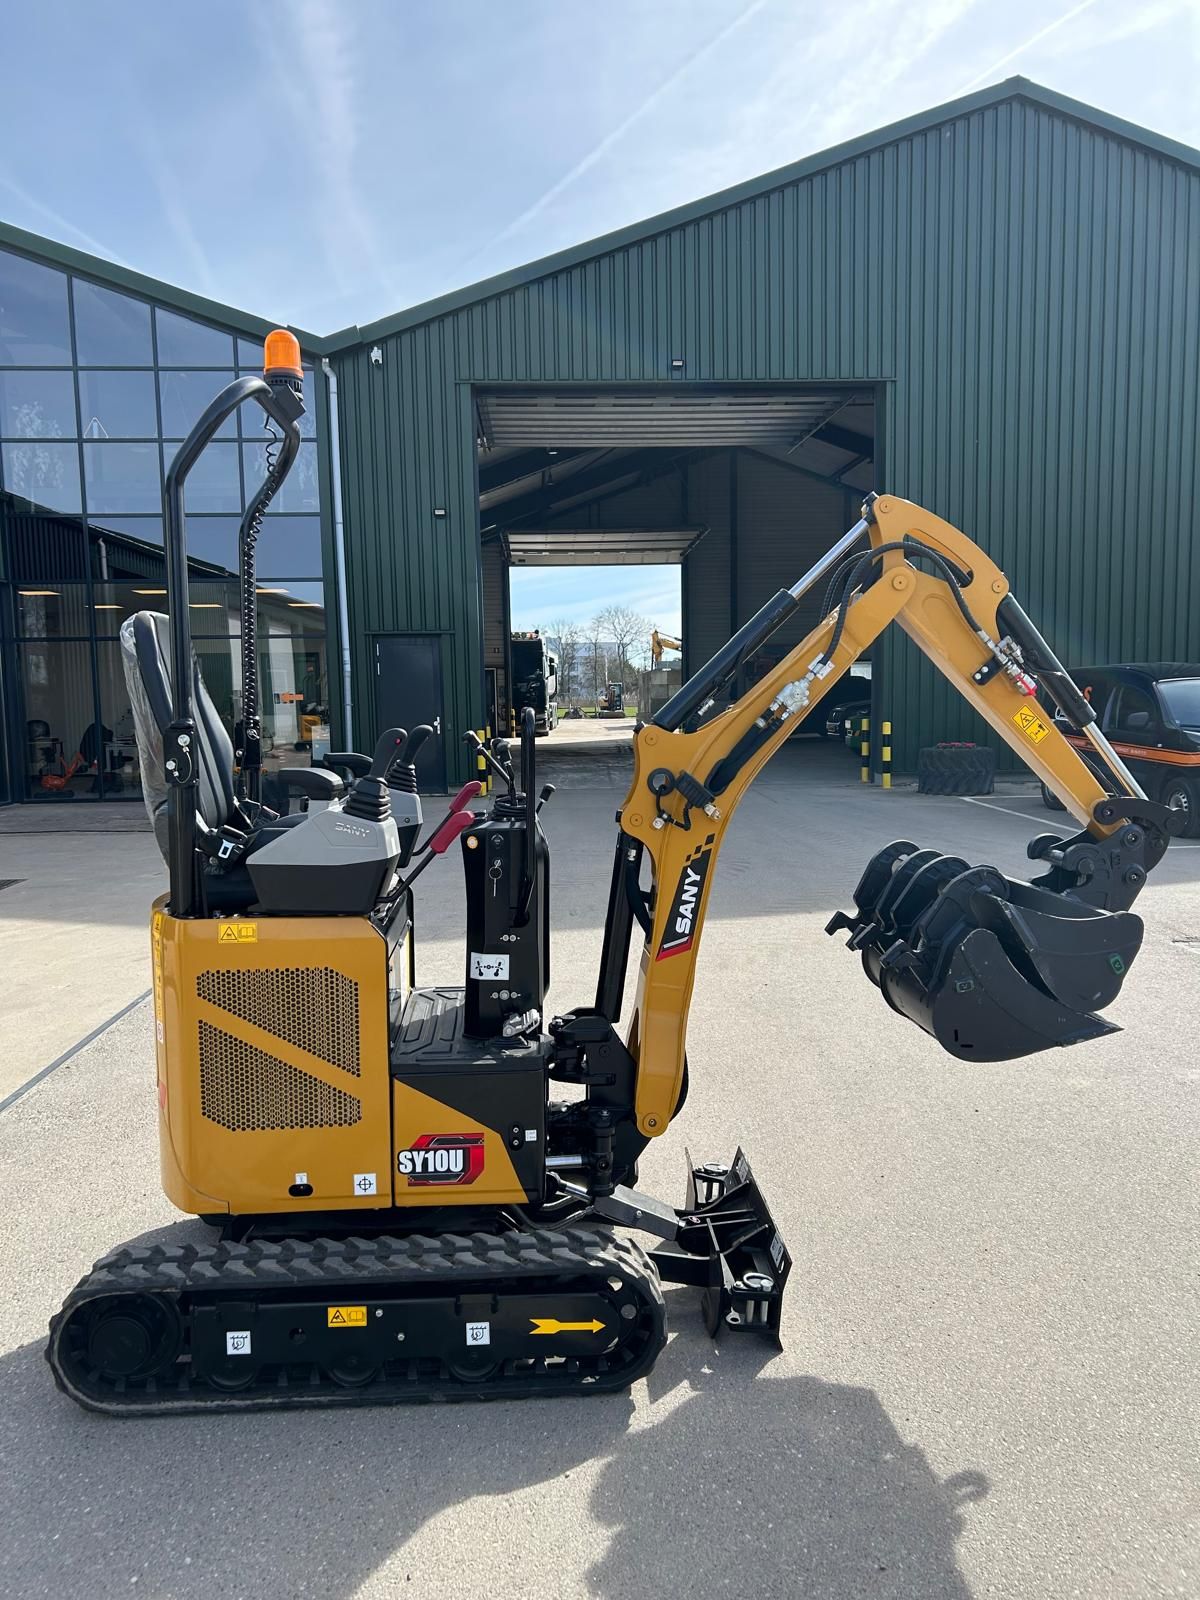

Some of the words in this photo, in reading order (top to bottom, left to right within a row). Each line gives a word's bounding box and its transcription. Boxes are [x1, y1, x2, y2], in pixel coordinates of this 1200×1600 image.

[335, 822, 370, 837] SANY
[675, 867, 701, 935] SANY
[398, 1149, 464, 1174] SY10U
